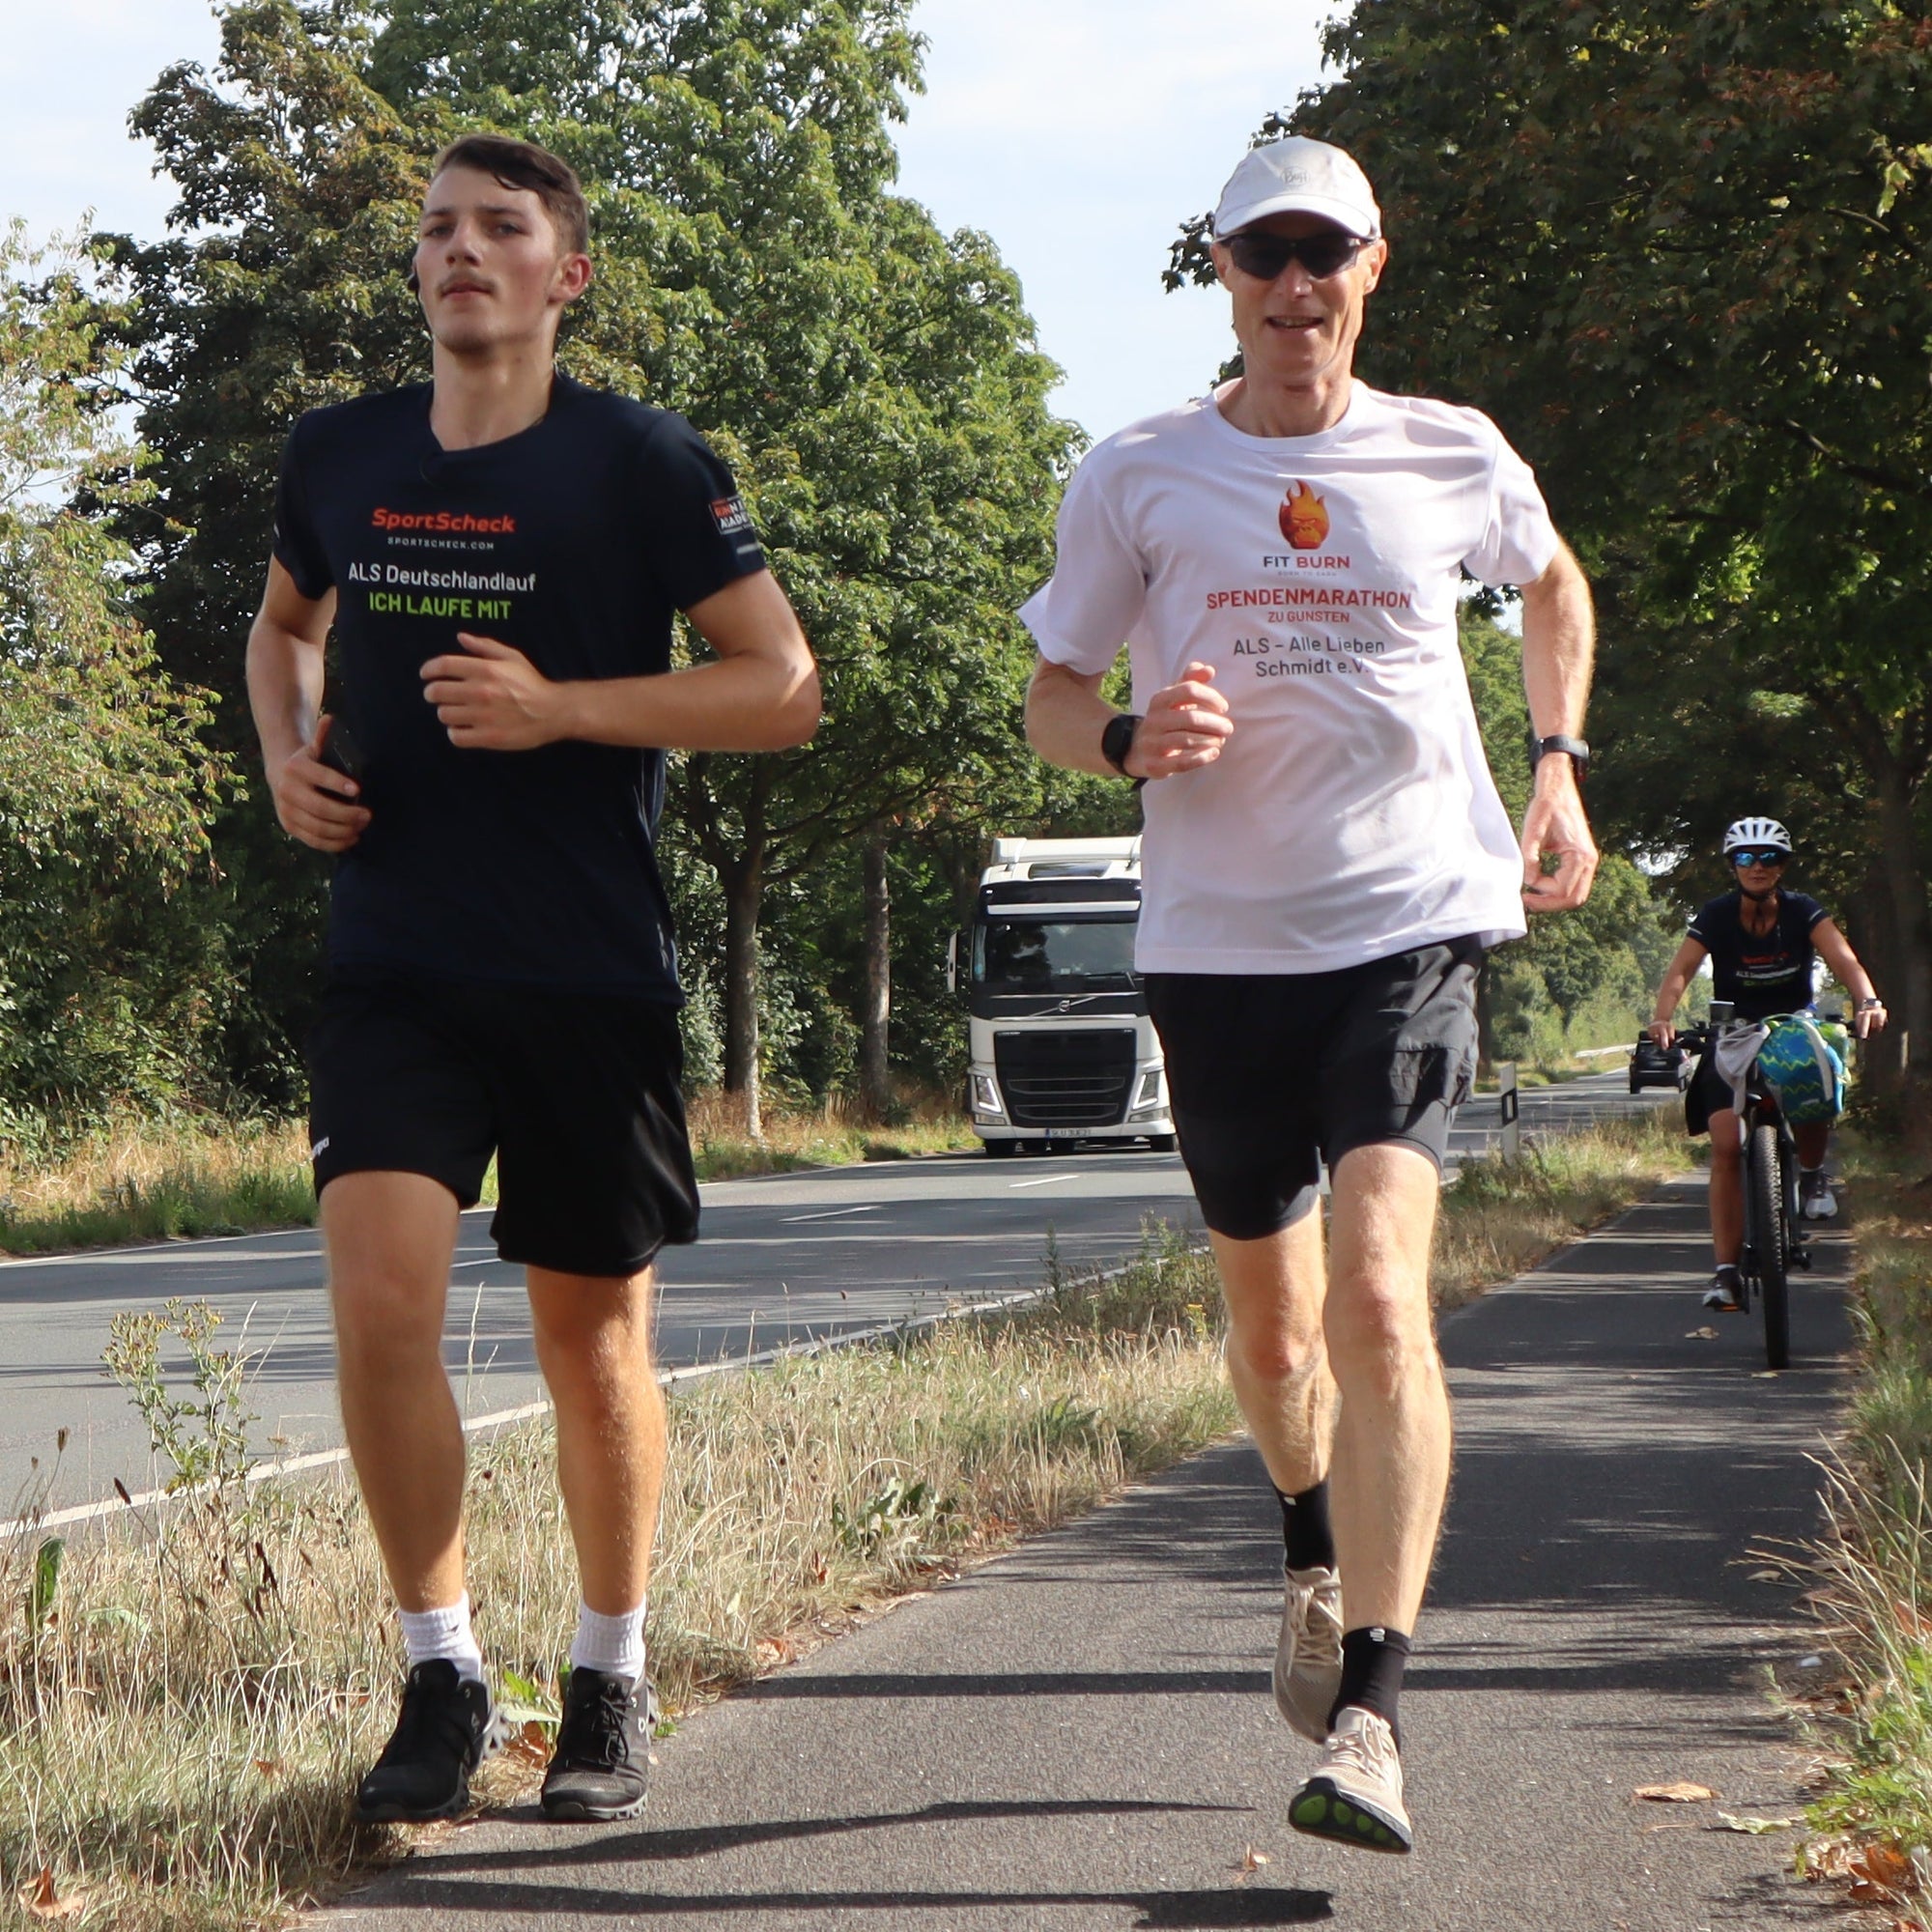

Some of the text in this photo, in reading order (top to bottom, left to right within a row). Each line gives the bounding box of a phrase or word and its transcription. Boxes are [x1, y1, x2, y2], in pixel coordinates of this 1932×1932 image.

[371, 508, 517, 533] SportScheck
[387, 536, 495, 551] SPORTSCHECK.COM
[1263, 555, 1350, 569] FIT BURN
[348, 562, 536, 592] ALS Deutschlandlauf
[368, 591, 512, 620] ICH LAUFE MIT
[1207, 588, 1411, 610] SPENDENMARATHON
[1267, 611, 1350, 623] ZU GUNSTEN
[1234, 638, 1270, 656] ALS
[1289, 637, 1321, 653] Alle
[1325, 636, 1385, 654] Lieben
[1256, 658, 1332, 677] Schmidt
